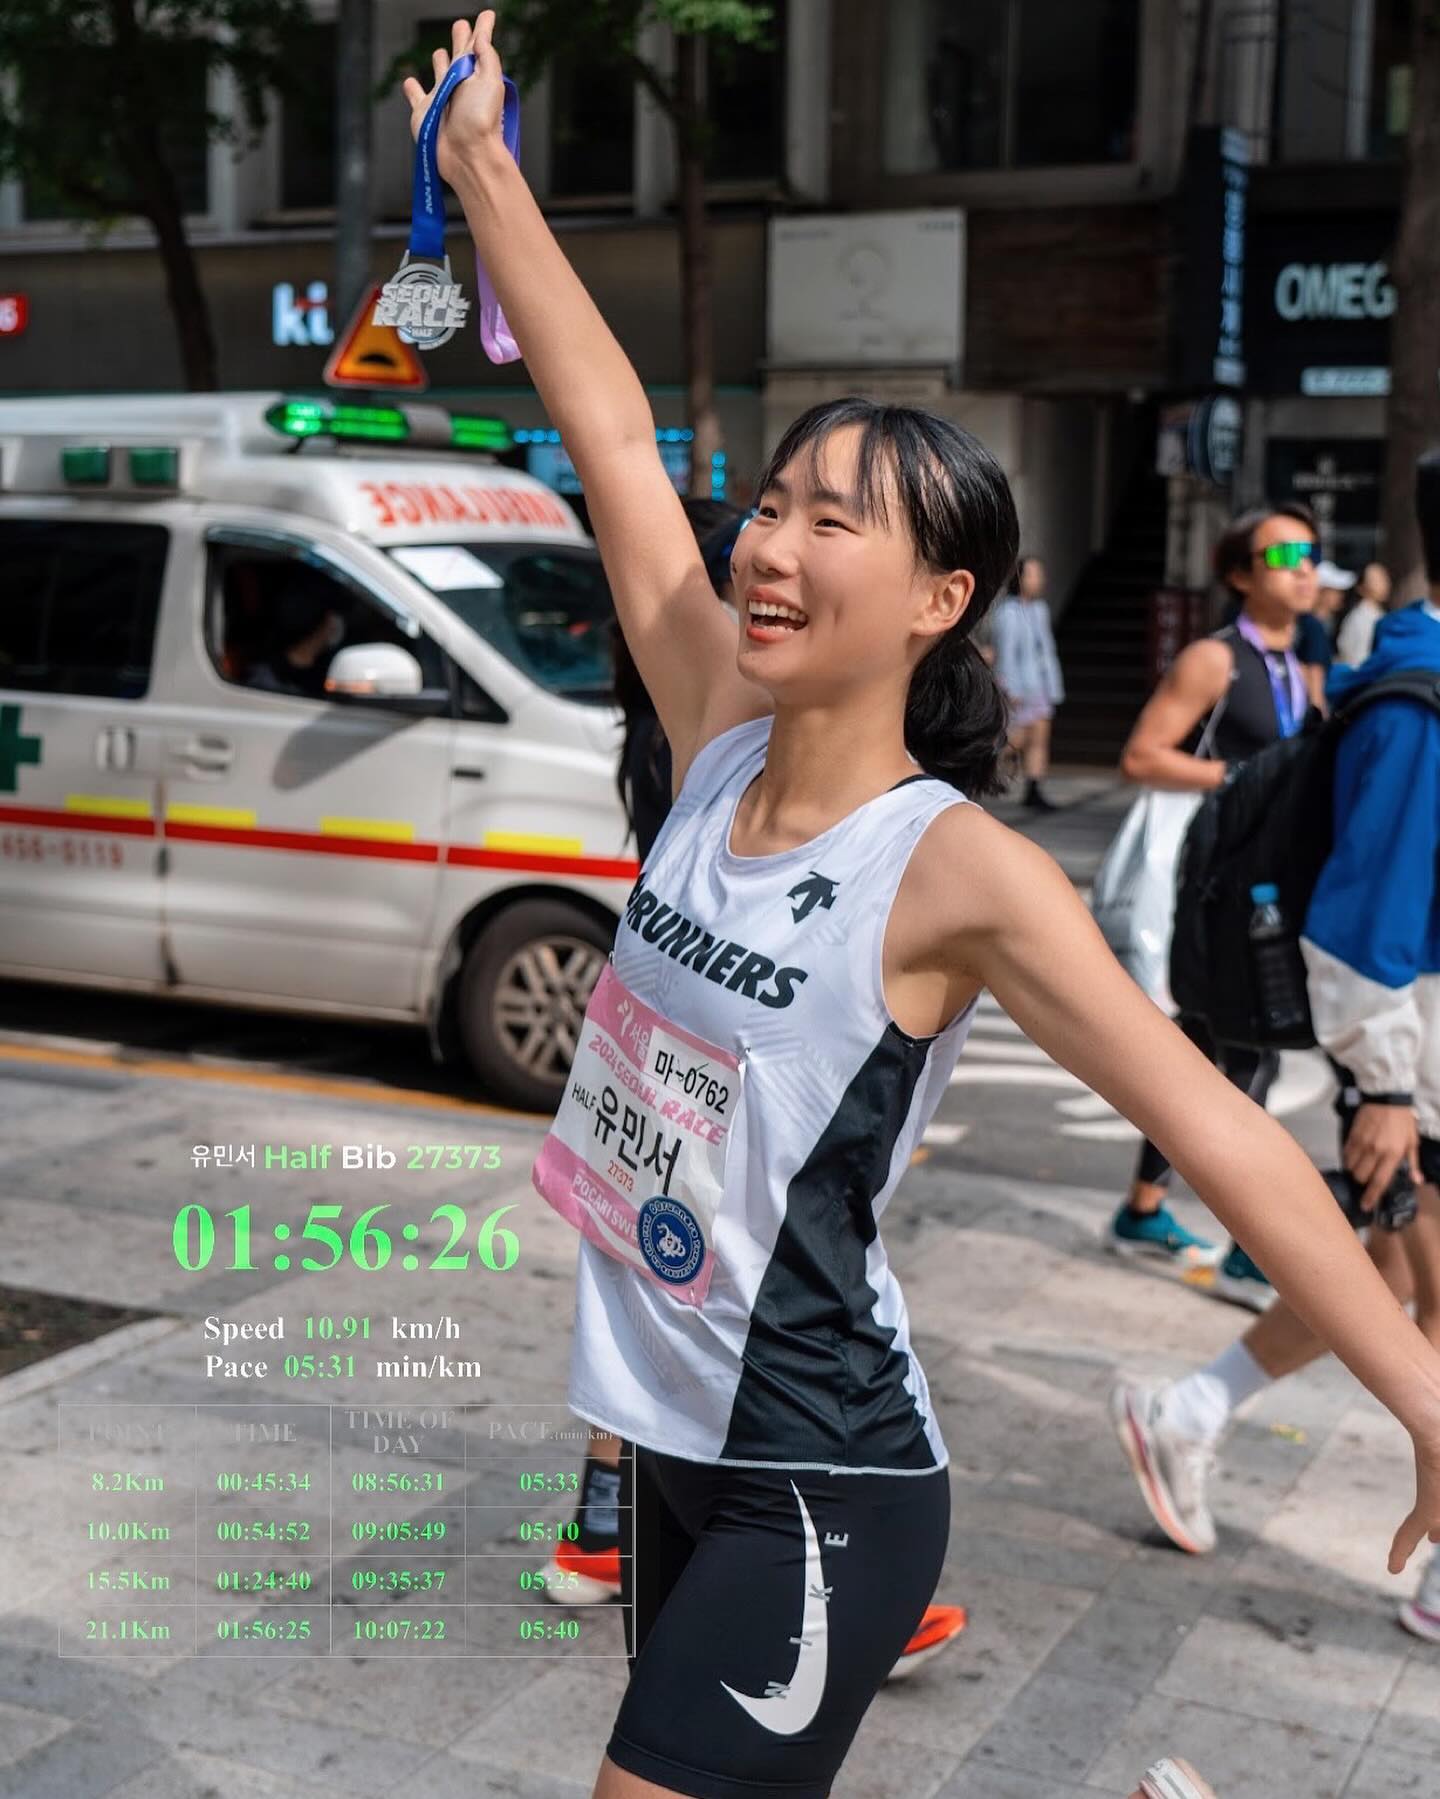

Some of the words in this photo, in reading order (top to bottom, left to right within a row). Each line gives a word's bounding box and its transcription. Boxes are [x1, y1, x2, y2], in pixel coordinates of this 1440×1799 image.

[372, 298, 471, 328] RACE
[382, 283, 463, 303] SEOUL
[1275, 262, 1397, 321] OMEG
[655, 1050, 729, 1114] 마-0762
[594, 1085, 682, 1197] 유민서
[659, 1098, 728, 1146] RACE
[572, 1173, 612, 1219] POCARI
[764, 1532, 849, 1700] NIKE
